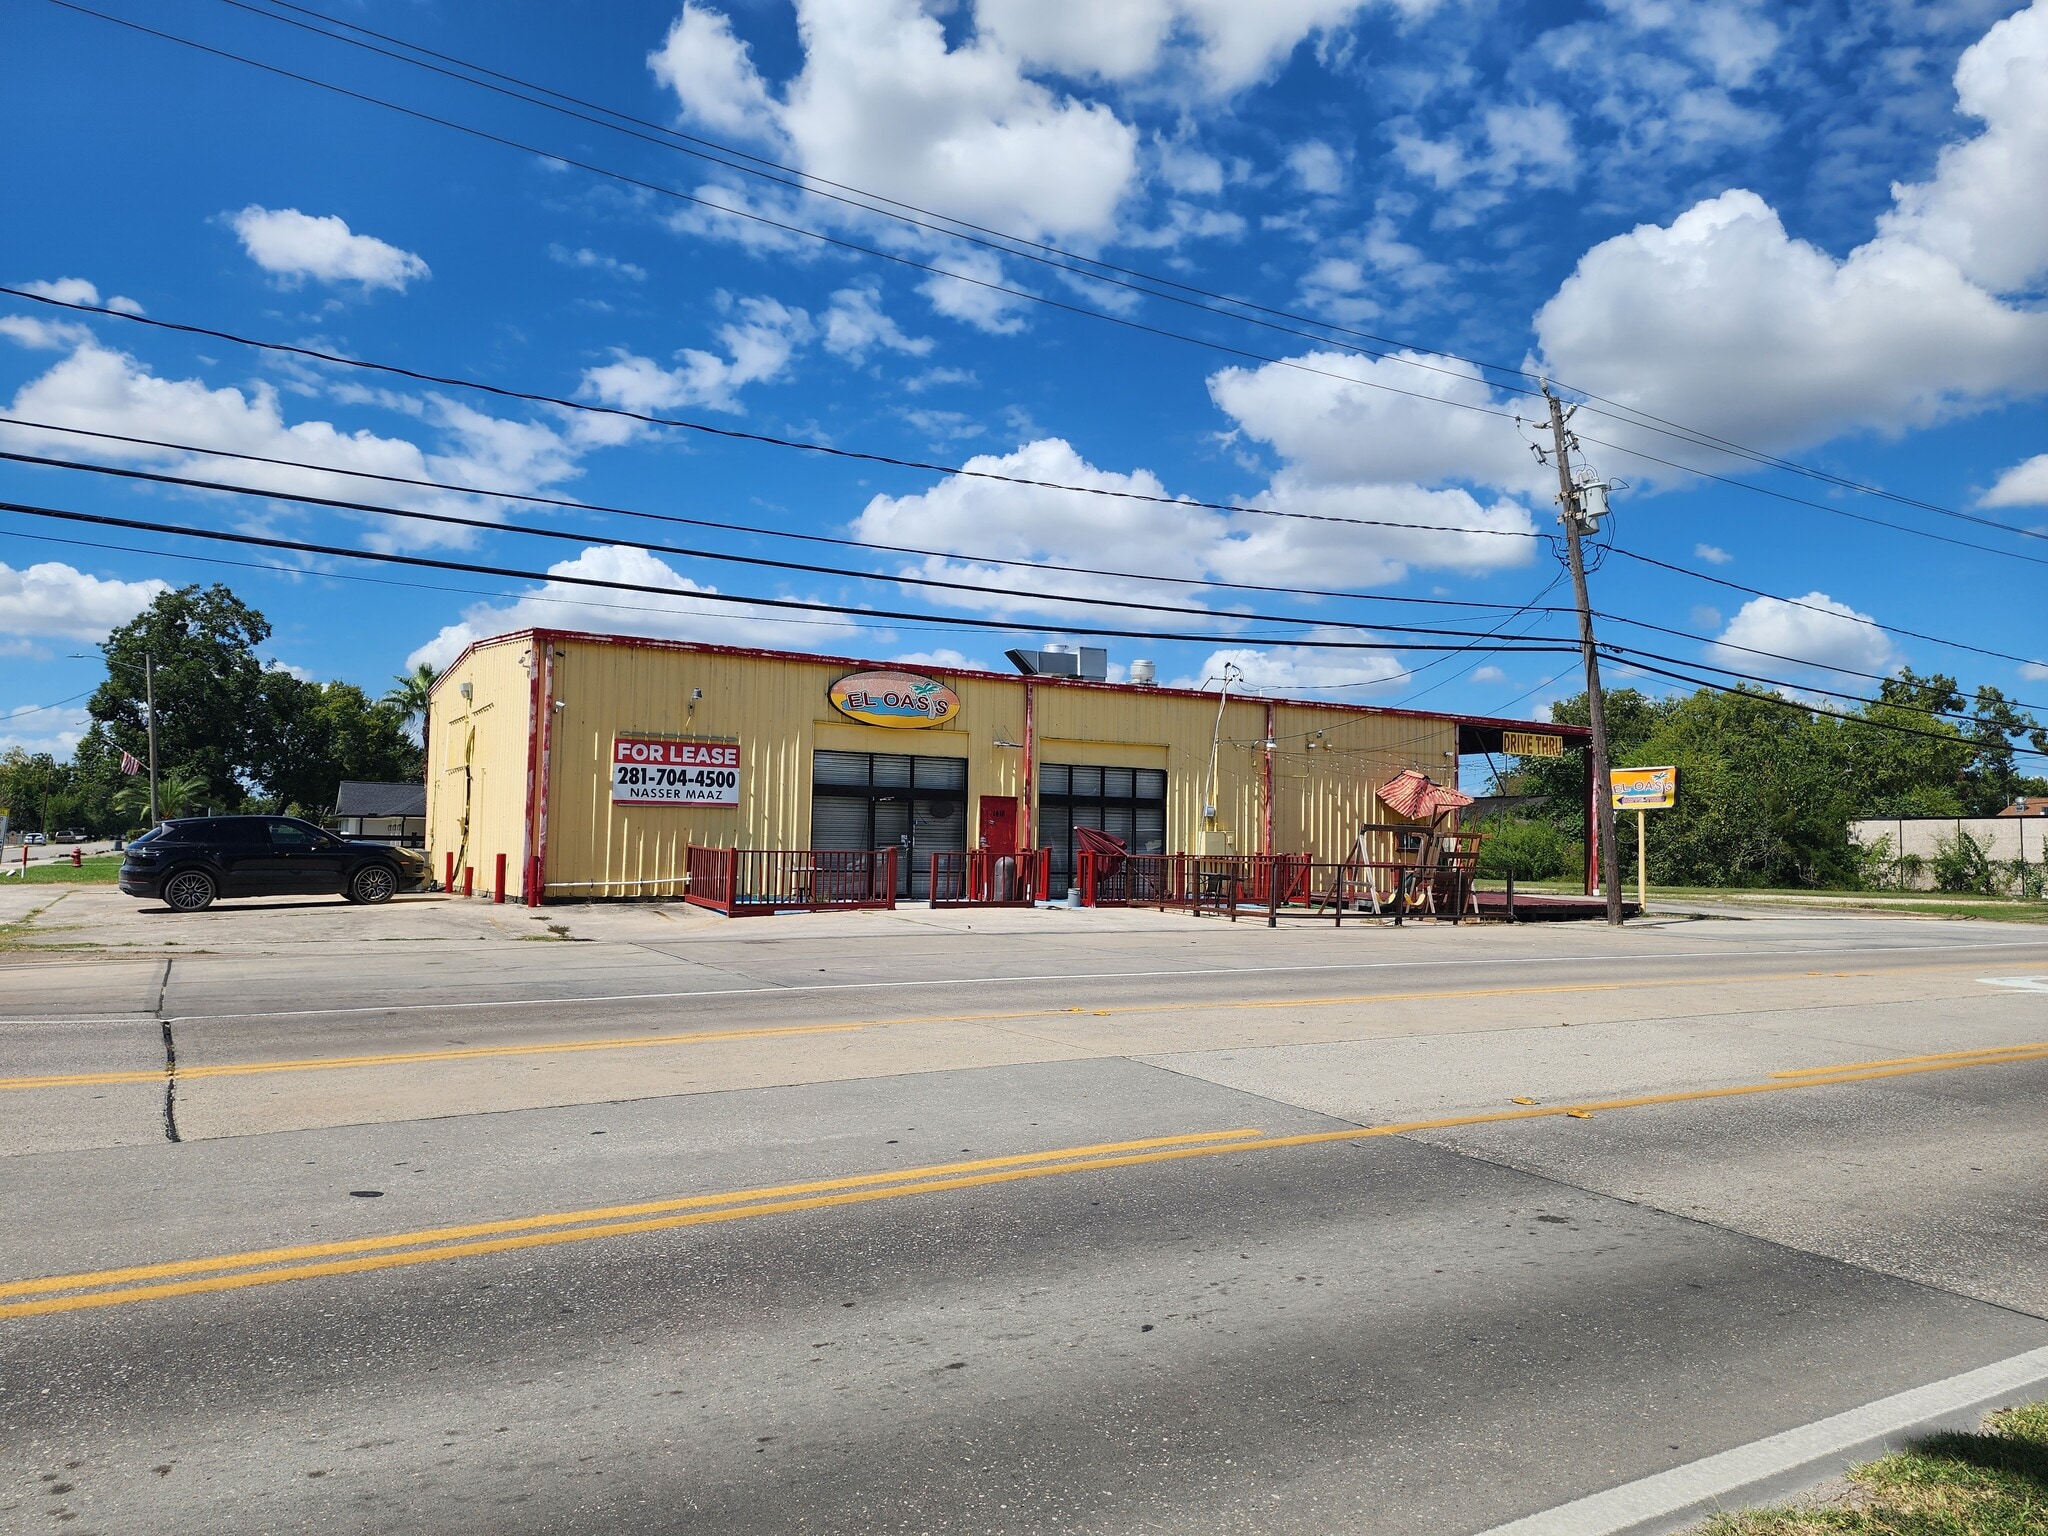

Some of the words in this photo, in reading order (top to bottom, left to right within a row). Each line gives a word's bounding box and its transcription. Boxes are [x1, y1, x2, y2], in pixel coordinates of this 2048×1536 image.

[847, 691, 877, 709] EL
[617, 742, 664, 762] FOR
[670, 745, 737, 765] LEASE
[1504, 733, 1533, 755] DRIVE
[1535, 735, 1562, 757] THRU
[617, 766, 736, 788] 281-704-4500
[630, 787, 681, 799] NASSER
[685, 789, 723, 800] MAAZ
[1613, 783, 1629, 794] EL
